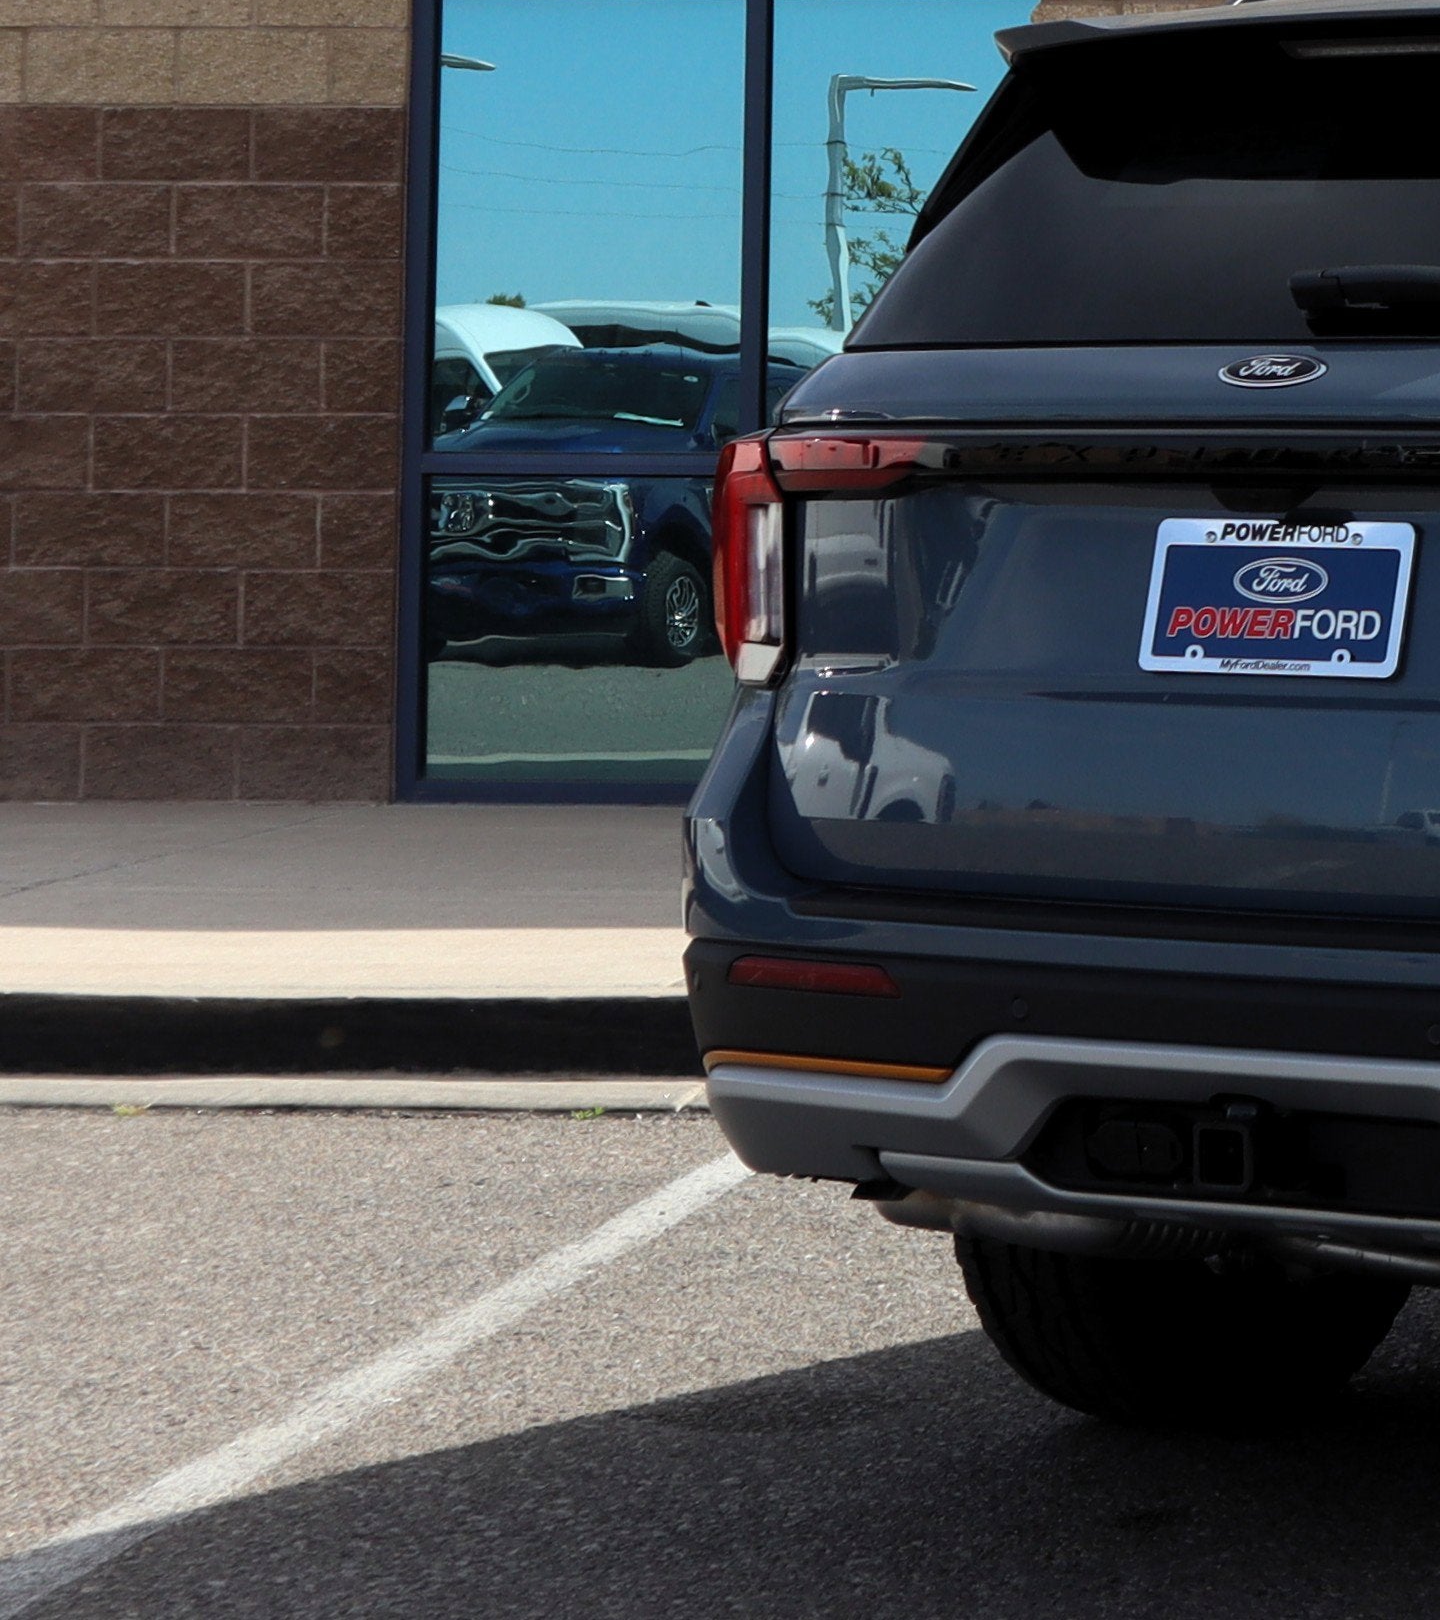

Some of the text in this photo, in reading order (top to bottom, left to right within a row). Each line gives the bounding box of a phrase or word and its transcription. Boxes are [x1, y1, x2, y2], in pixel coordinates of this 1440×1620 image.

[1239, 357, 1302, 377] Ford
[1220, 523, 1349, 543] POWERFORD
[1251, 565, 1308, 593] Ford
[1166, 606, 1381, 641] POWERFORD
